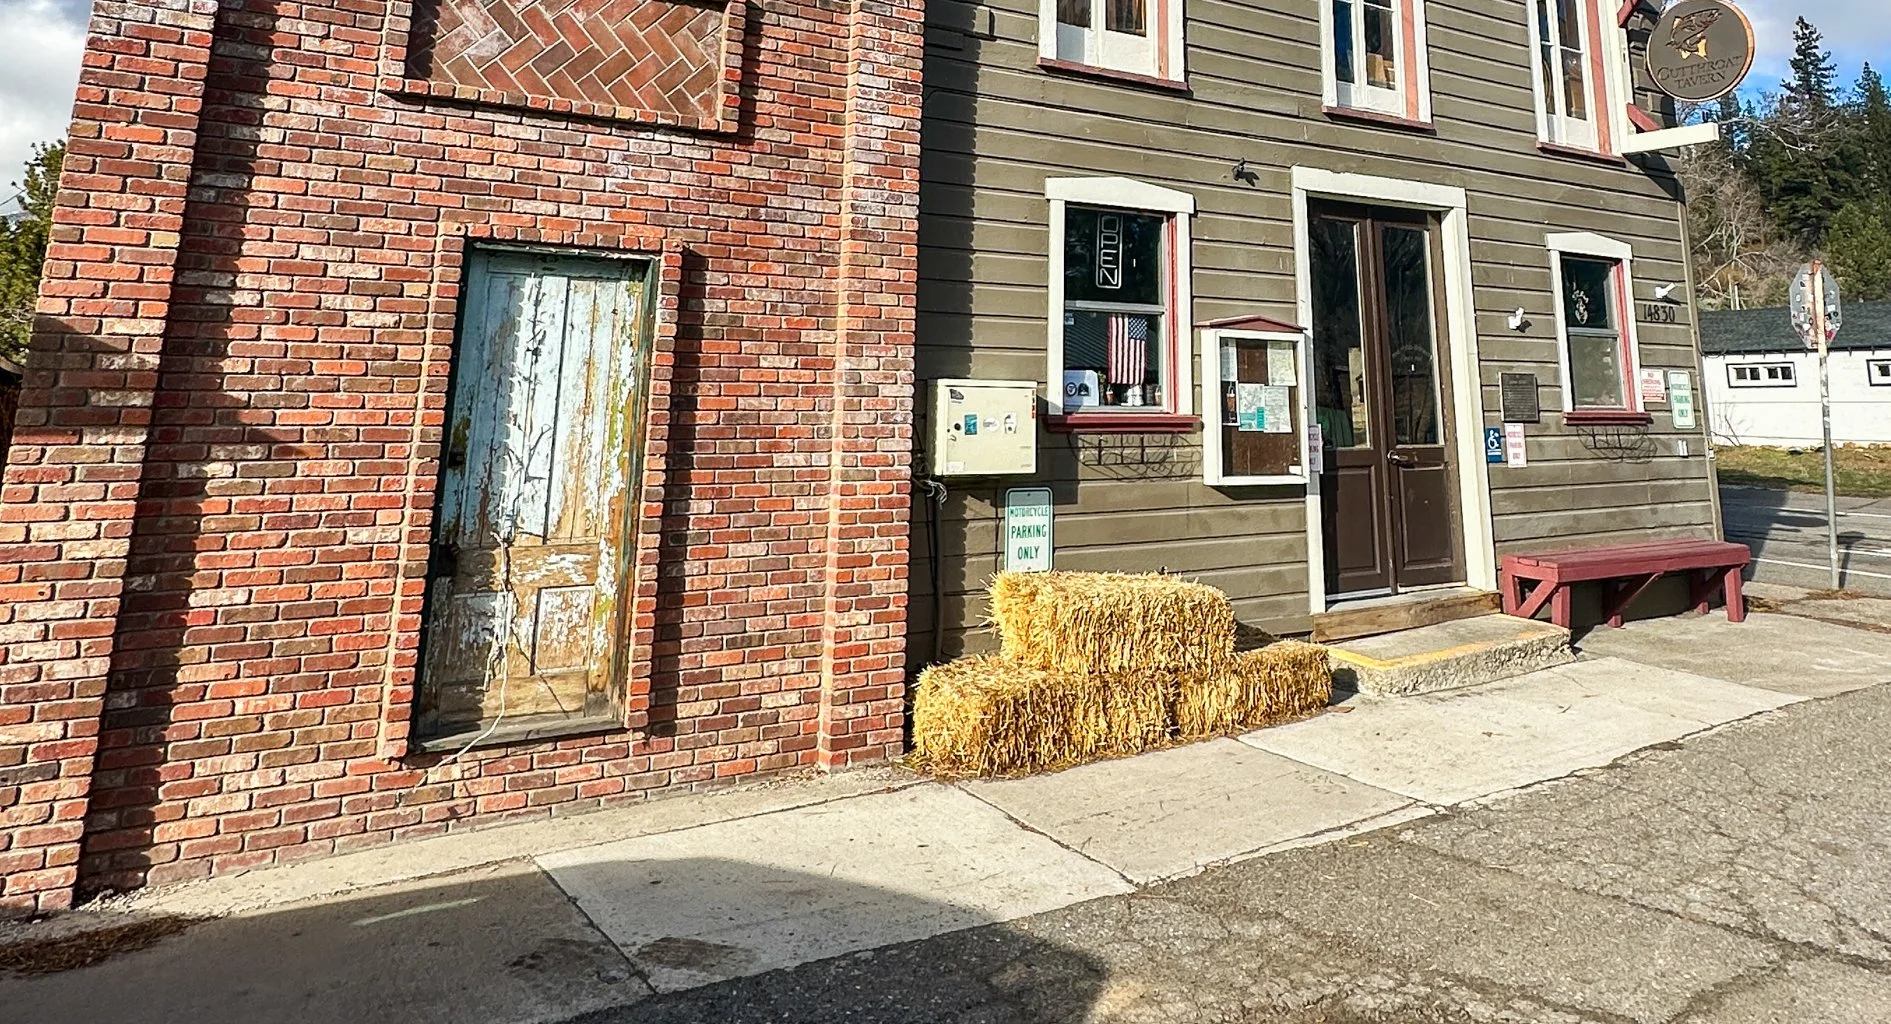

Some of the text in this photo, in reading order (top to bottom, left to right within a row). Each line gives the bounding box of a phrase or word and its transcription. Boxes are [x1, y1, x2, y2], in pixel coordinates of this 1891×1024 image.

[1675, 70, 1726, 89] TAVERN
[1100, 215, 1120, 286] OPEN
[1643, 303, 1676, 324] 14830
[1009, 506, 1049, 517] MOTORCYCLE
[1011, 524, 1047, 539] PARKING
[1018, 545, 1040, 560] ONLY
